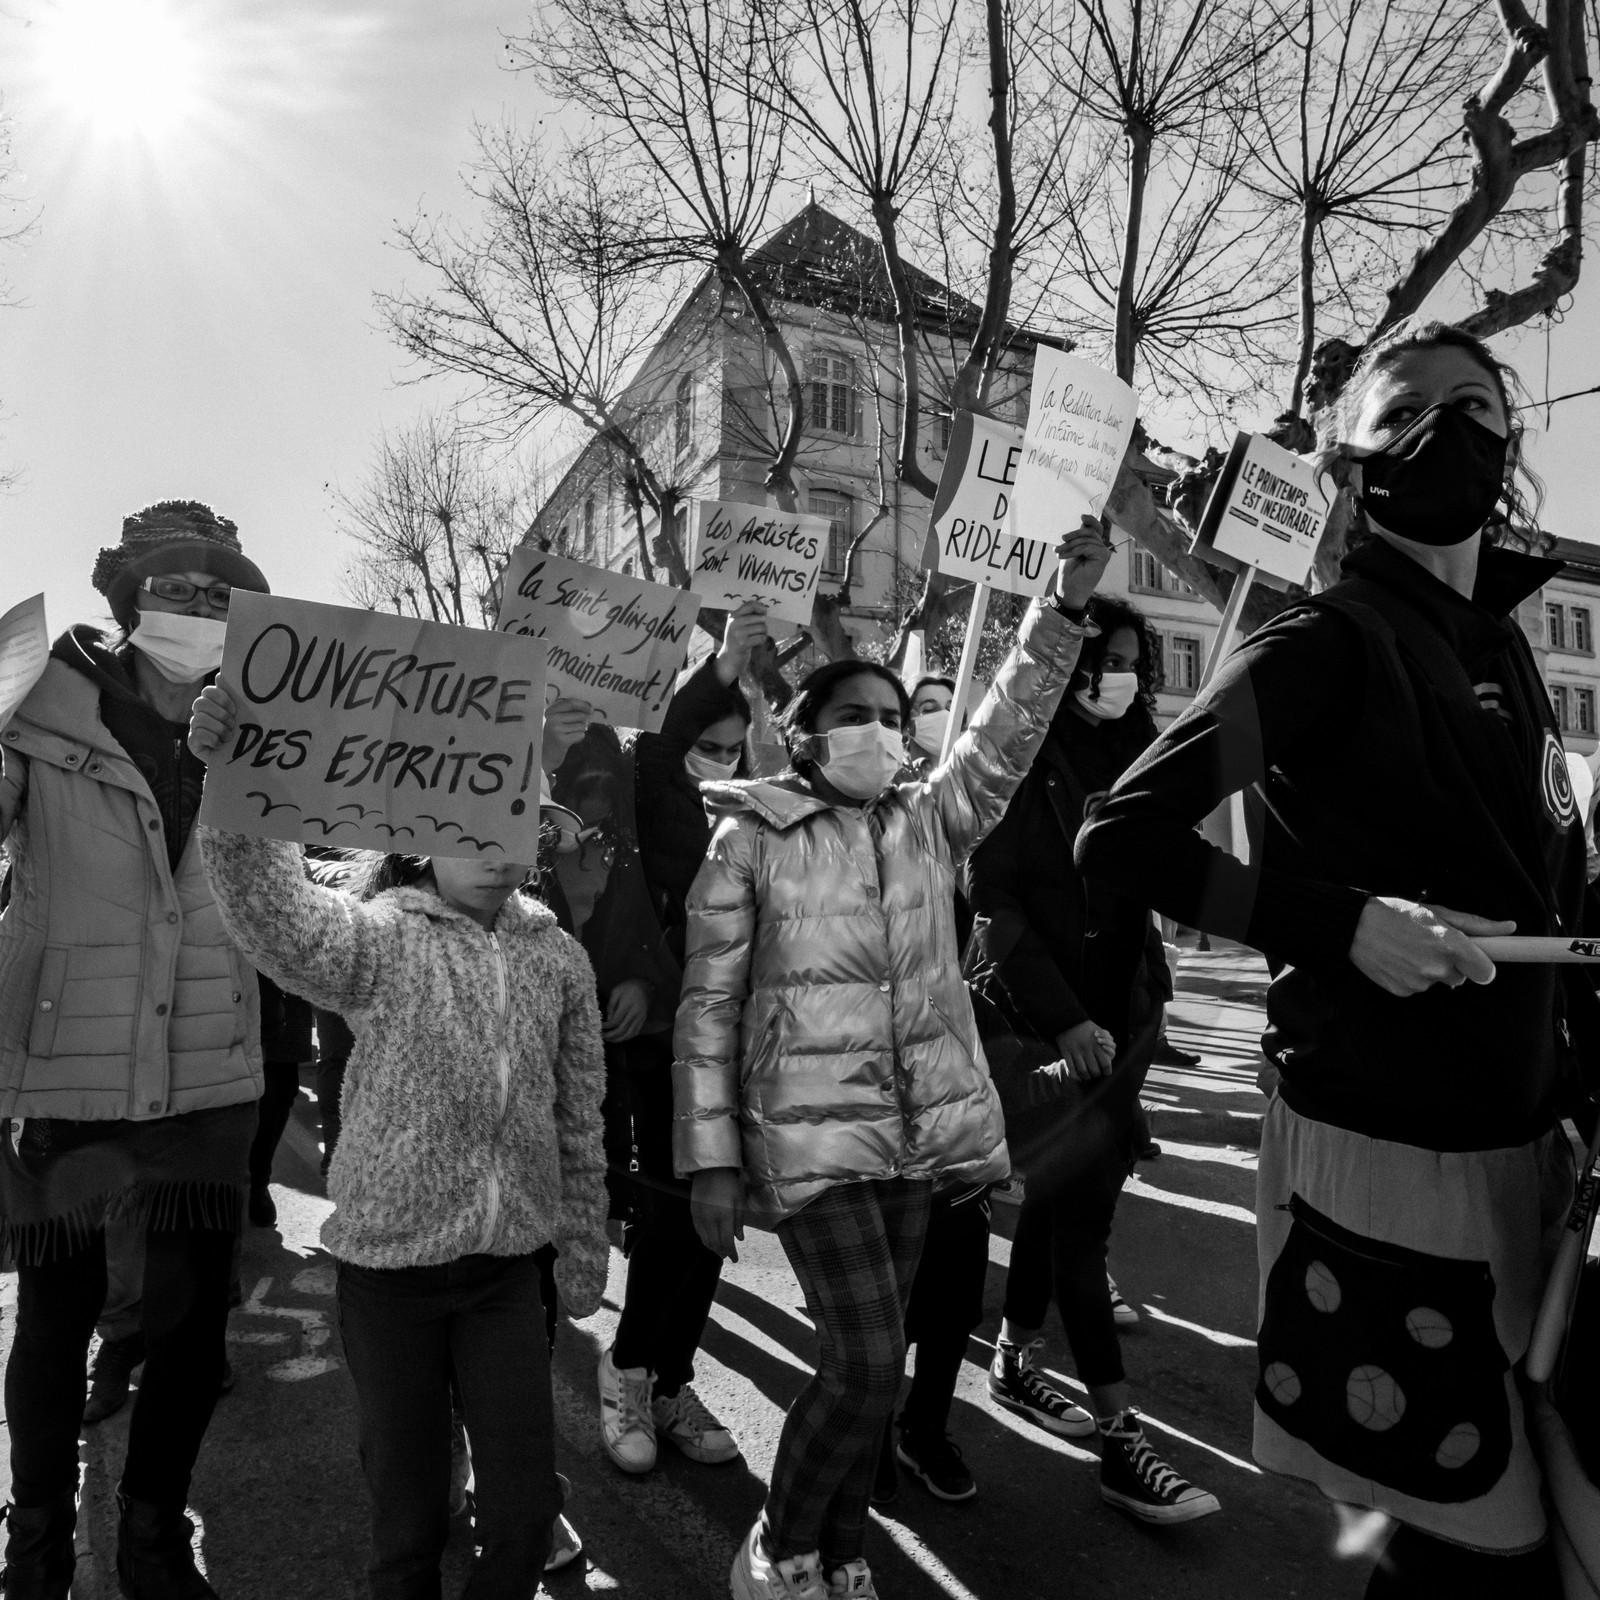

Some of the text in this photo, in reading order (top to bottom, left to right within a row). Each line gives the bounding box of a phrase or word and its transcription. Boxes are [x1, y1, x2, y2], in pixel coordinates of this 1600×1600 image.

[1026, 445, 1059, 469] n'est
[1056, 456, 1079, 481] pas
[1241, 459, 1310, 508] LE PRINTEMPS
[1241, 488, 1320, 539] EST INEXORABLE
[241, 622, 532, 725] OUVERTURE
[226, 722, 312, 770] DES
